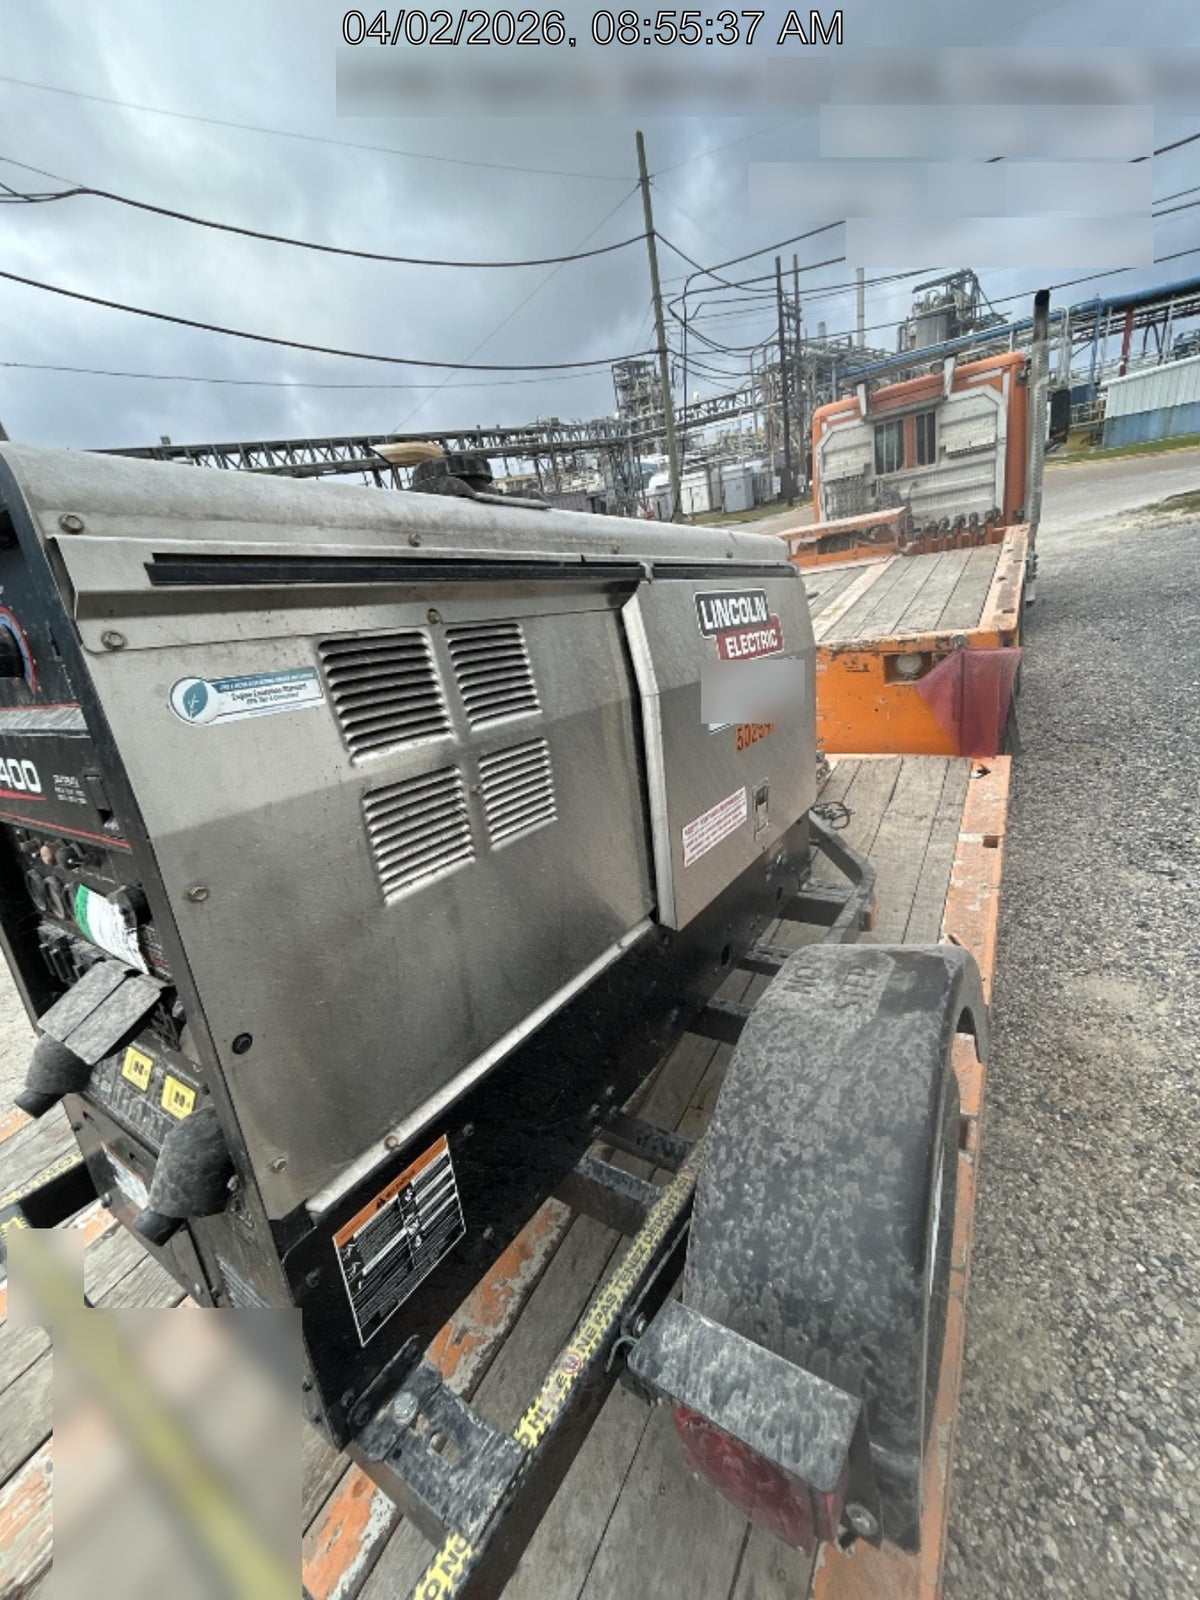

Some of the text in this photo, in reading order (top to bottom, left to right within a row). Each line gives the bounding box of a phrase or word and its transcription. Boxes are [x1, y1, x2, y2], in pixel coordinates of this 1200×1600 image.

[700, 596, 767, 630] LINCOLN
[725, 629, 778, 658] ELECTRIC
[594, 1292, 617, 1322] PAS
